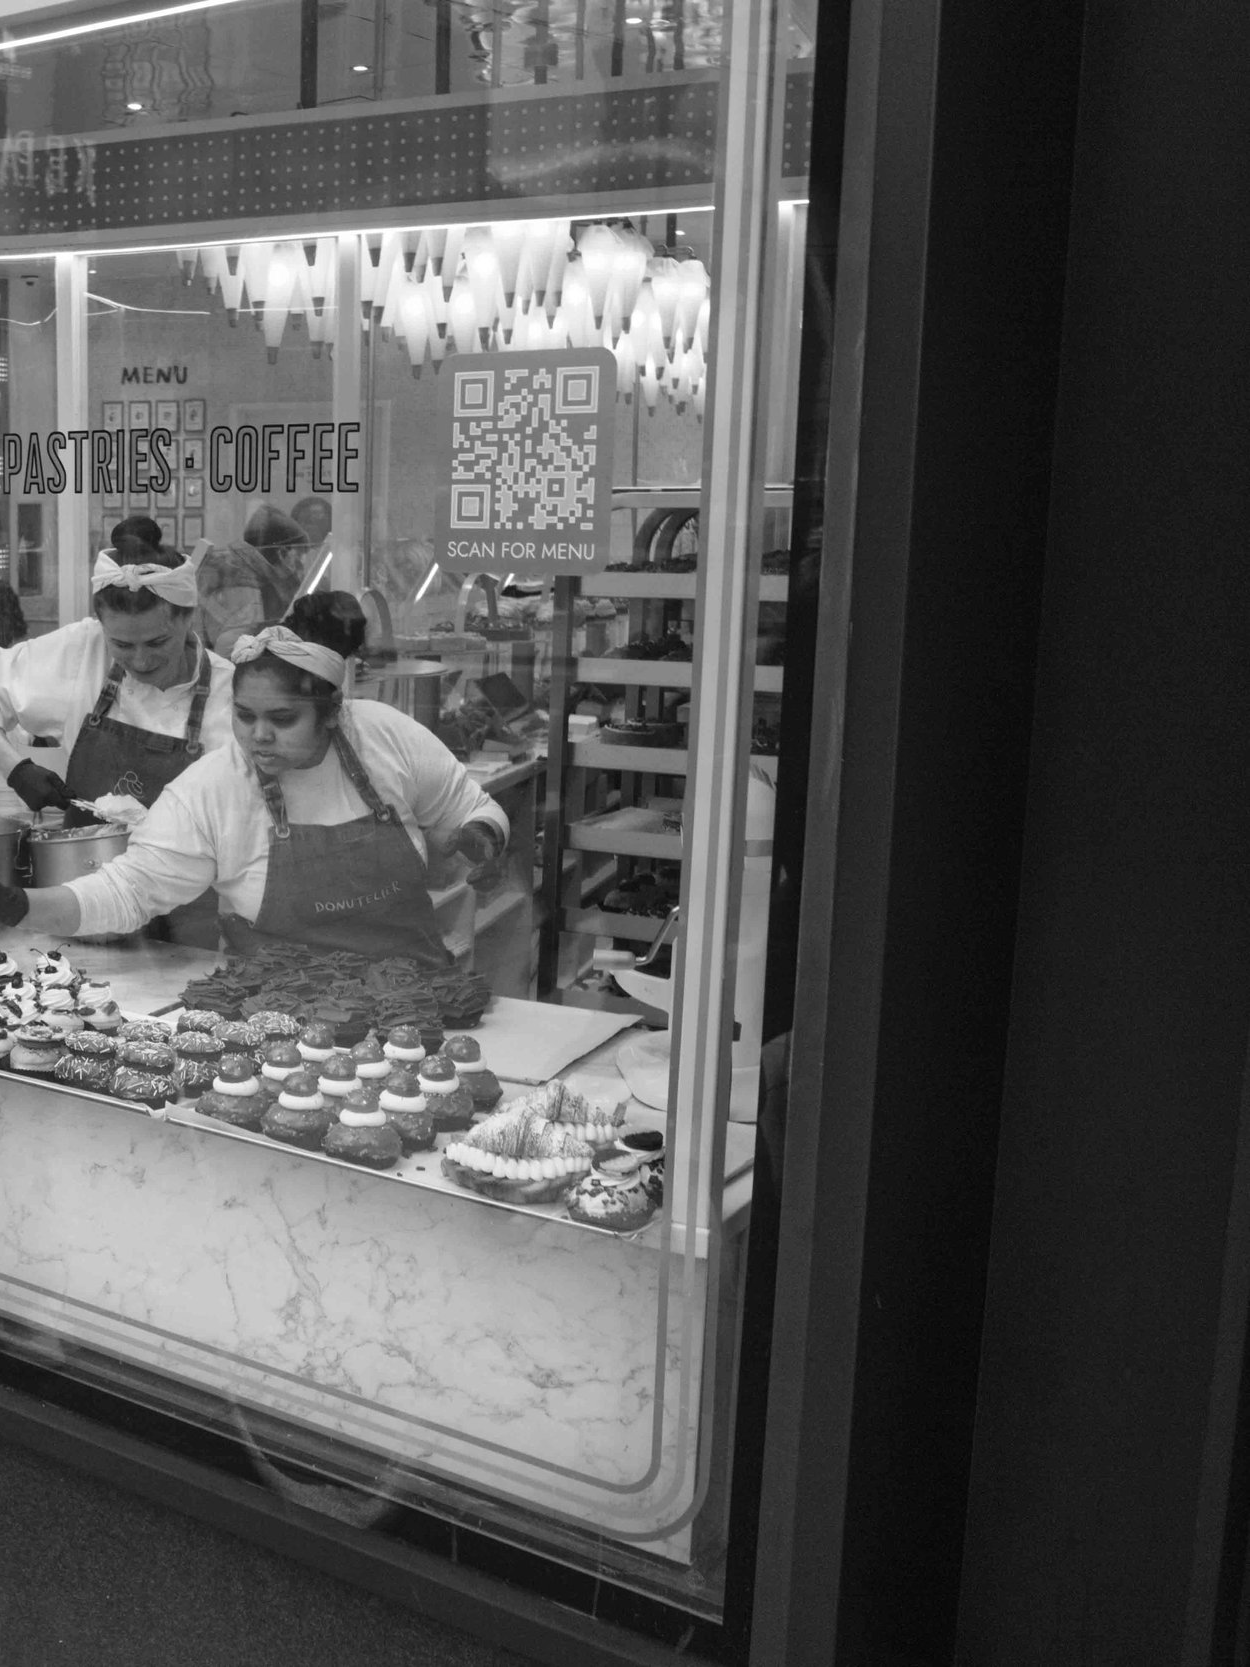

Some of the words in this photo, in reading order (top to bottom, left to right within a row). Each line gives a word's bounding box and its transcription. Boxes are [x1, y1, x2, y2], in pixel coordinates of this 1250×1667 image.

[121, 365, 188, 385] MENU
[3, 428, 172, 494] PASTRIES
[209, 422, 360, 493] COFFEE
[447, 541, 495, 558] SCAN
[501, 542, 536, 559] FOR
[541, 543, 595, 560] MENU
[314, 880, 402, 913] DONUTELIER
